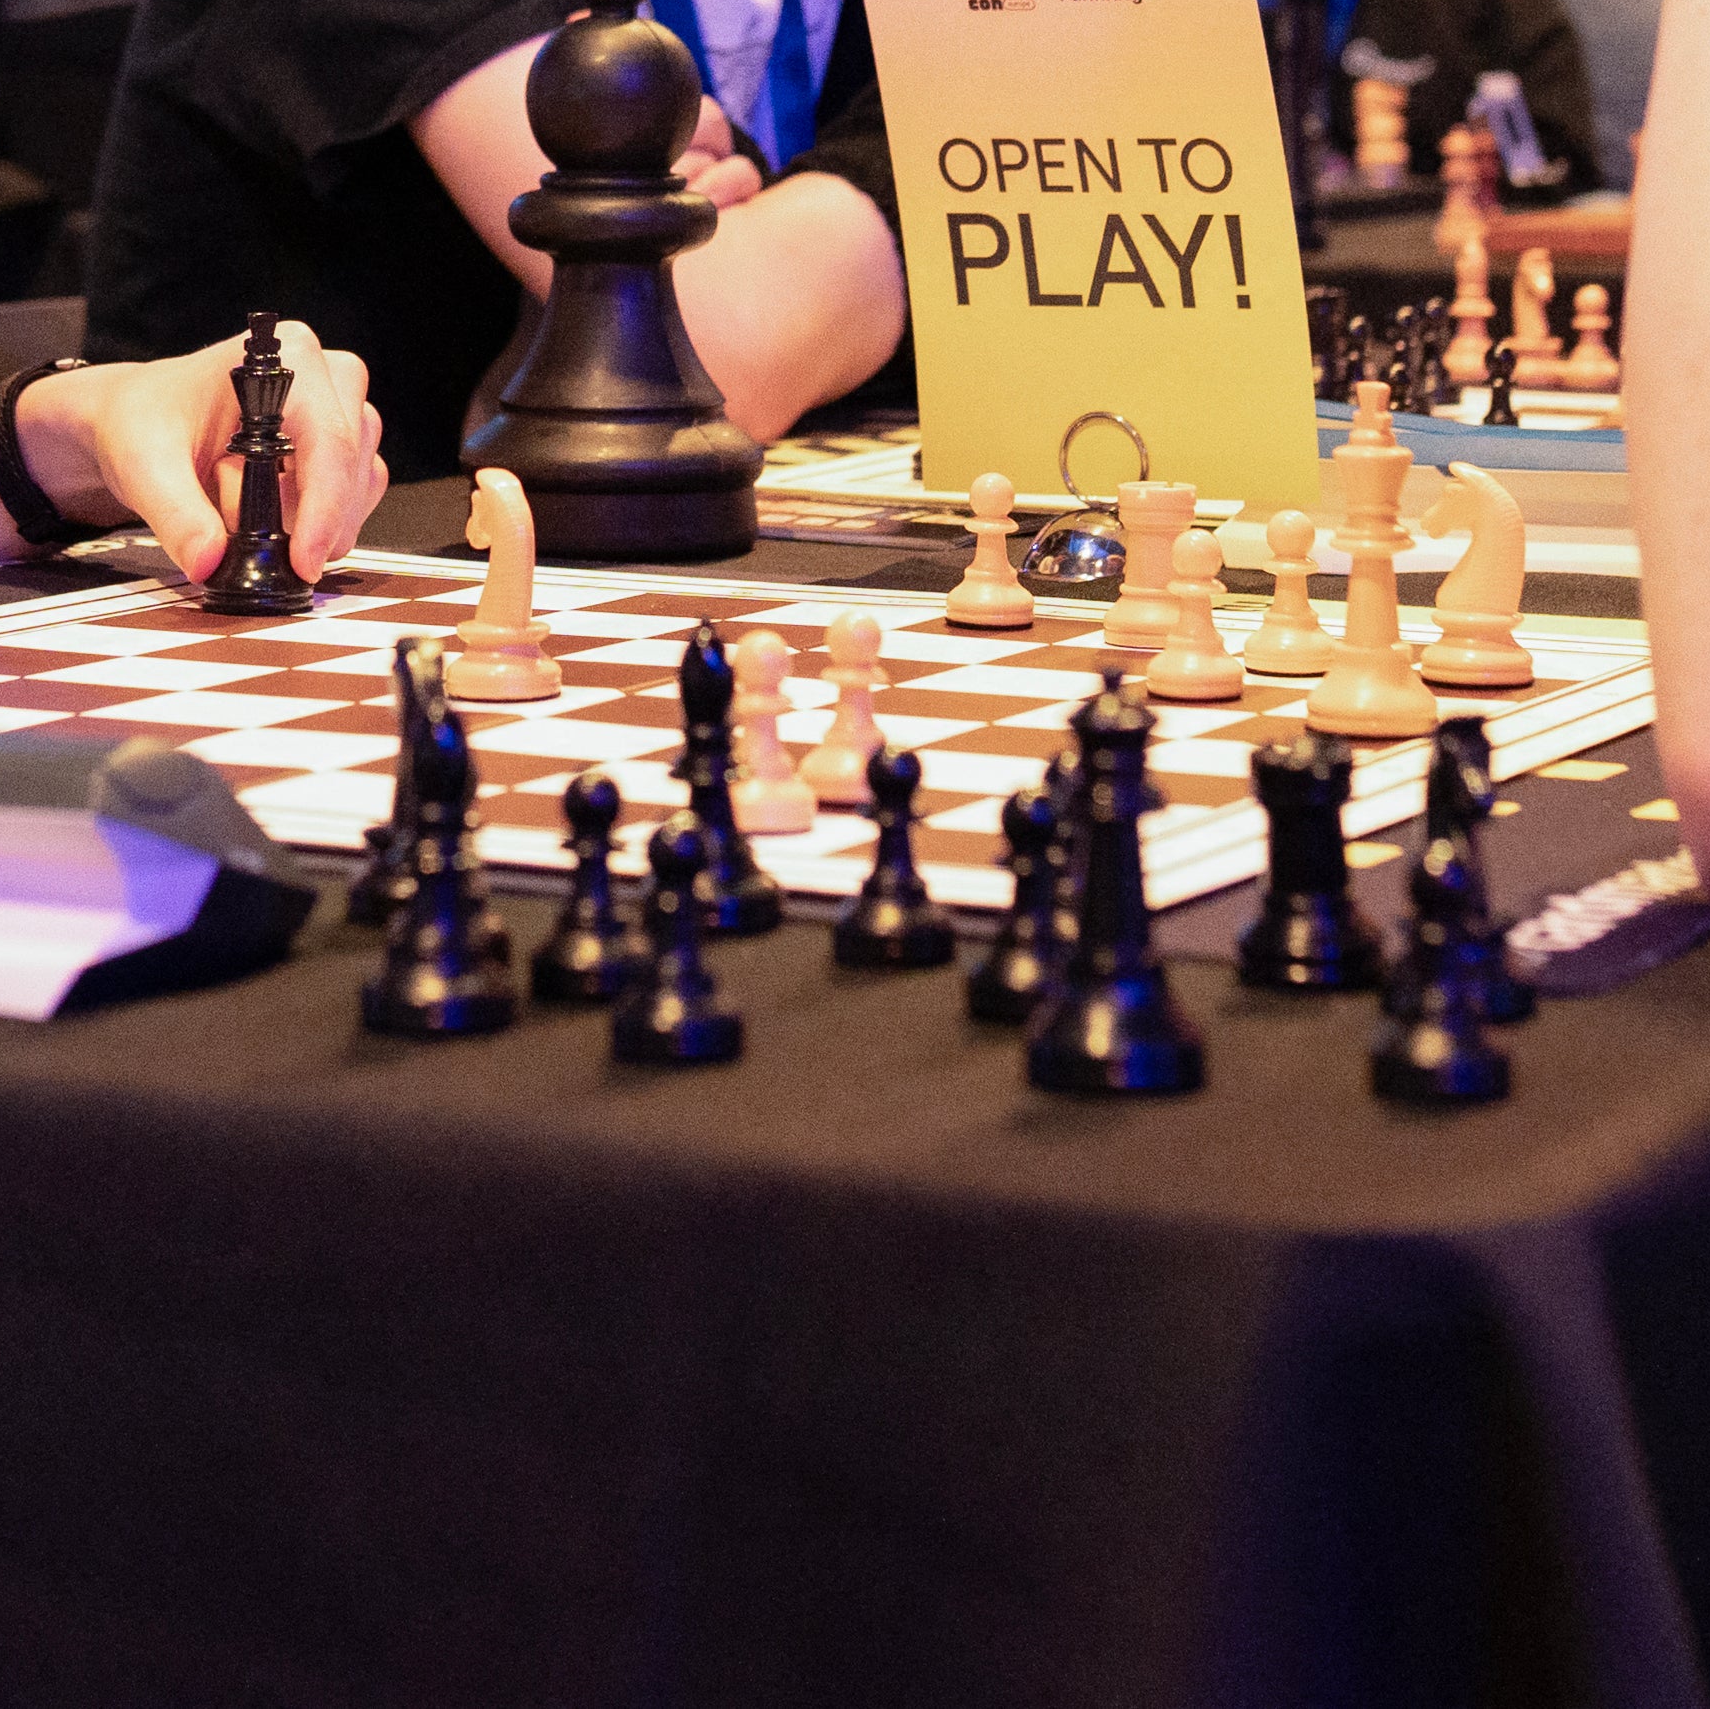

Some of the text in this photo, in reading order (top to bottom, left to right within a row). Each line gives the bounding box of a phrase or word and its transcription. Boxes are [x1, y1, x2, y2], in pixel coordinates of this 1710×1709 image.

[968, 0, 1003, 11] con
[937, 138, 1233, 194] OPEN TO
[946, 212, 1252, 310] PLAY!
